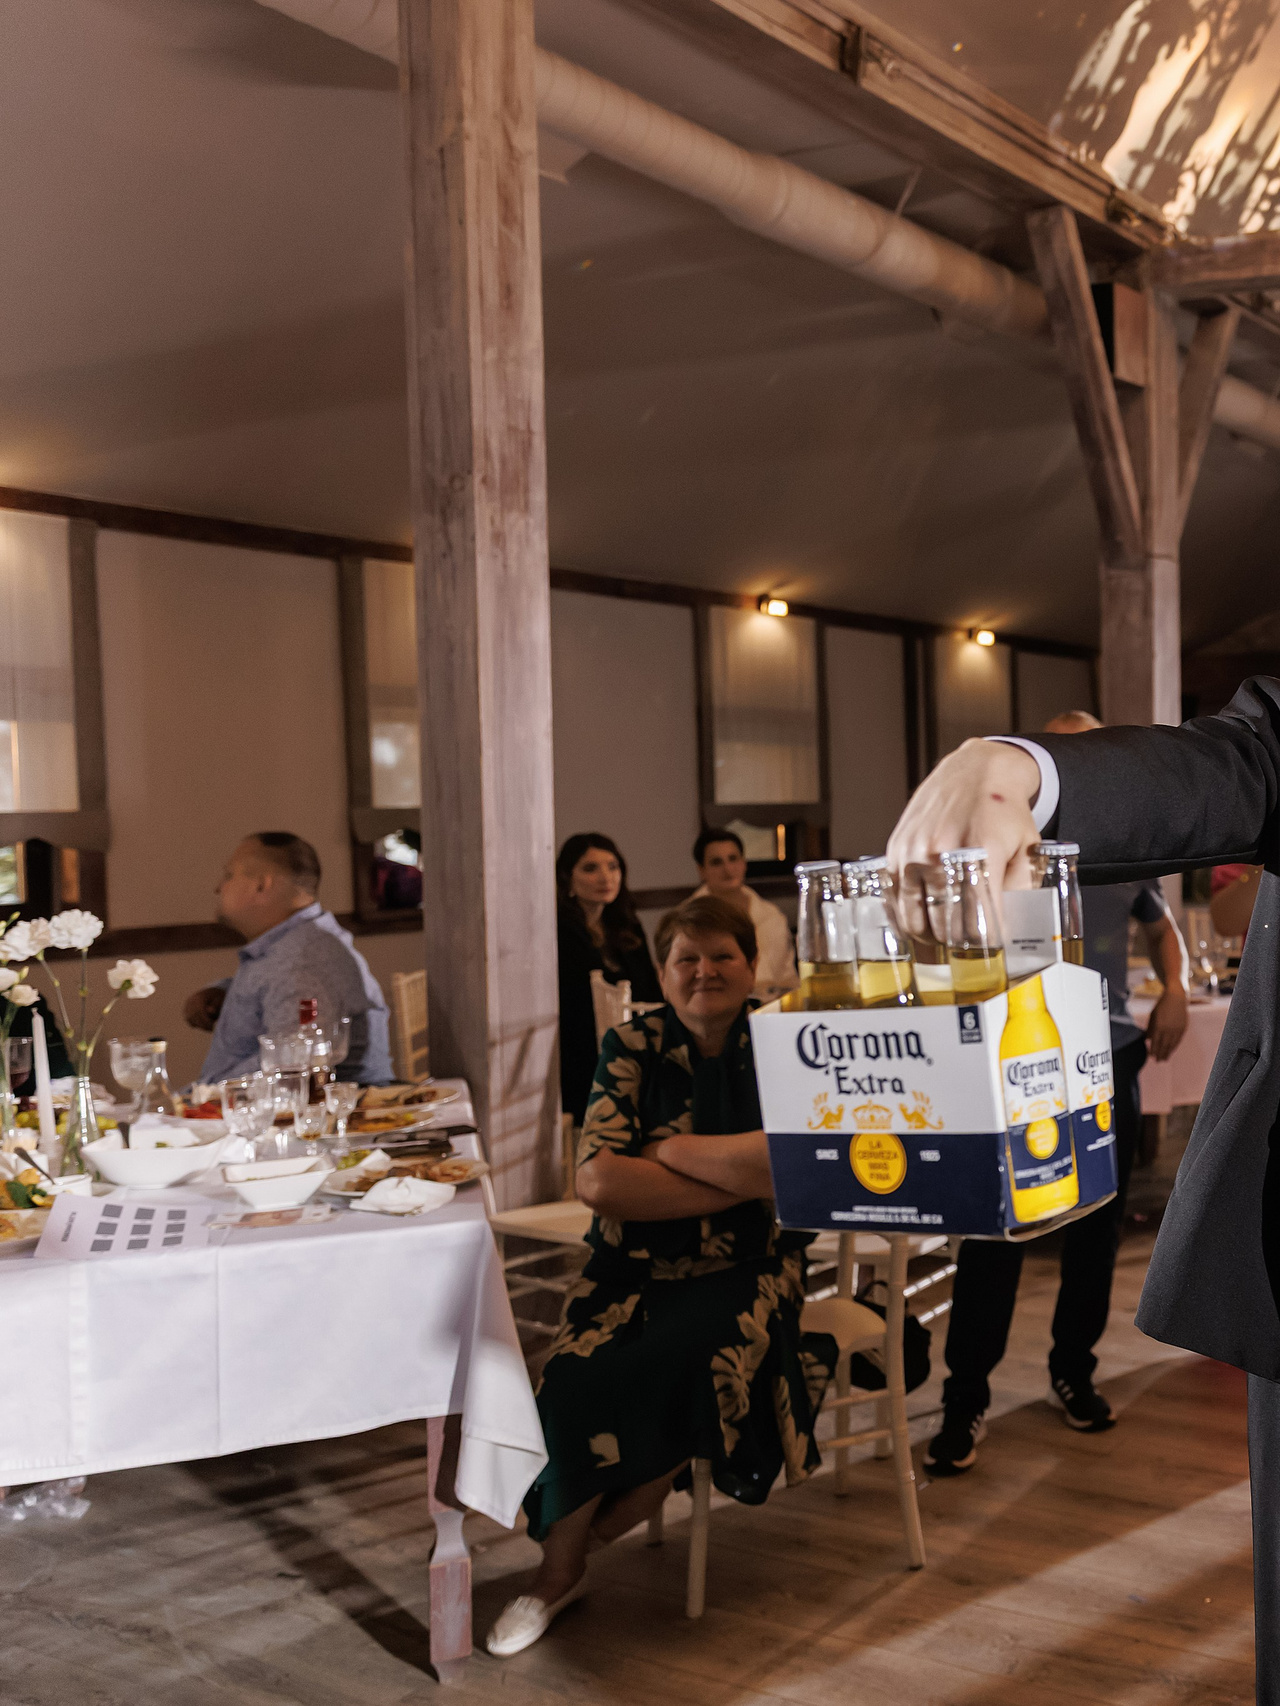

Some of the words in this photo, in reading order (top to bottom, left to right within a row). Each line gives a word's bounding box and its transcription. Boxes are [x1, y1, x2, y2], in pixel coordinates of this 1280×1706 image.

[963, 1011, 977, 1030] 6
[797, 1022, 926, 1070] Corona
[834, 1066, 906, 1096] Extra
[1007, 1058, 1061, 1086] Corona
